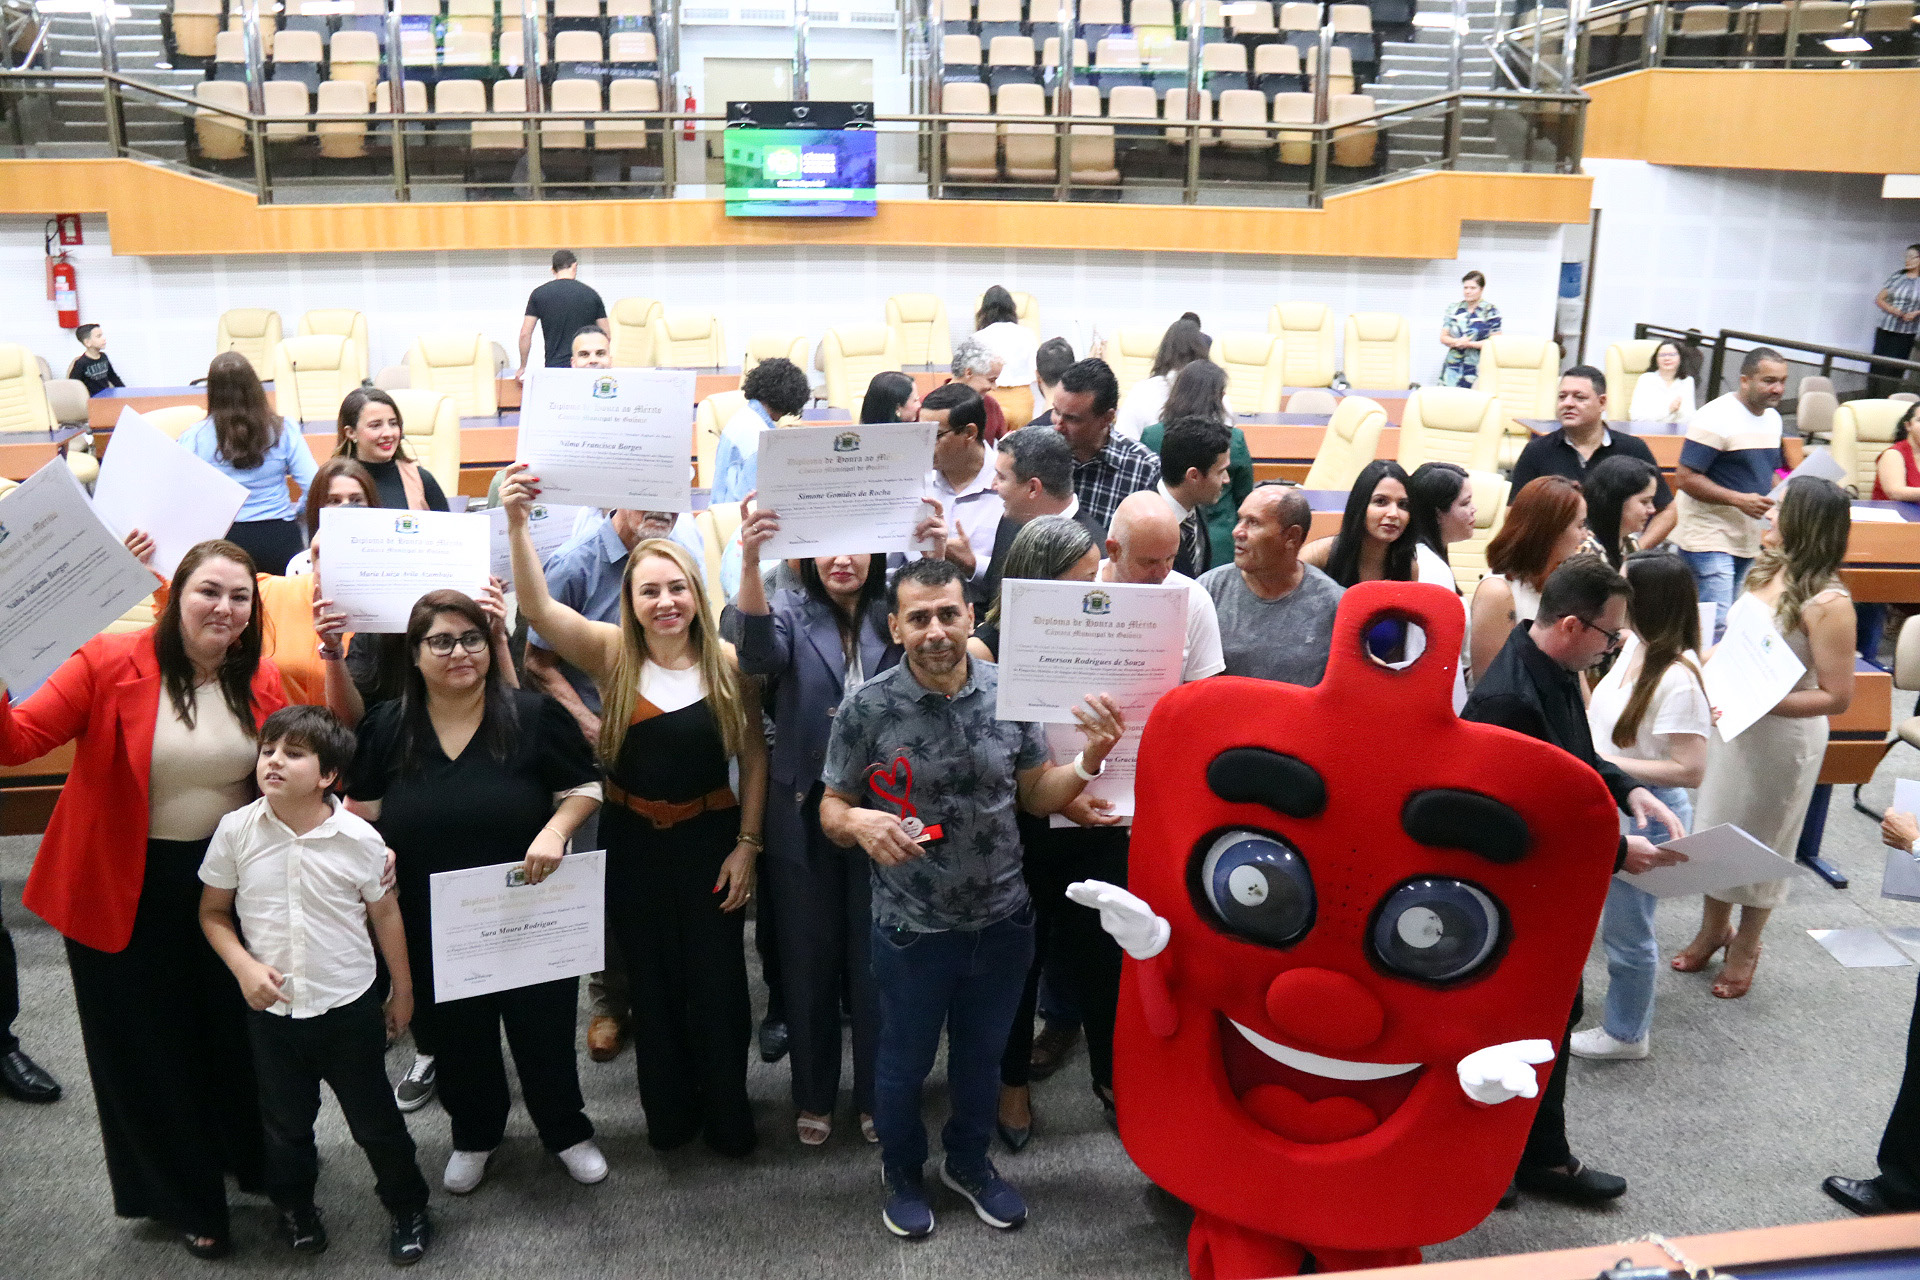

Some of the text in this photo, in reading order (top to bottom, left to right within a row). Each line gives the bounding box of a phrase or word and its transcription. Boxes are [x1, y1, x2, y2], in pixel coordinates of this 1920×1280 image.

[618, 443, 642, 451] Borges
[47, 561, 70, 580] Borges
[1033, 616, 1070, 625] Diploma
[1073, 619, 1083, 627] de
[1085, 619, 1113, 628] Honra
[1128, 621, 1157, 629] Mérito
[1039, 655, 1072, 663] Emerson
[1075, 656, 1111, 667] Rodrigues
[1114, 658, 1123, 666] de
[480, 920, 558, 938] Sara Moura Rodrigues
